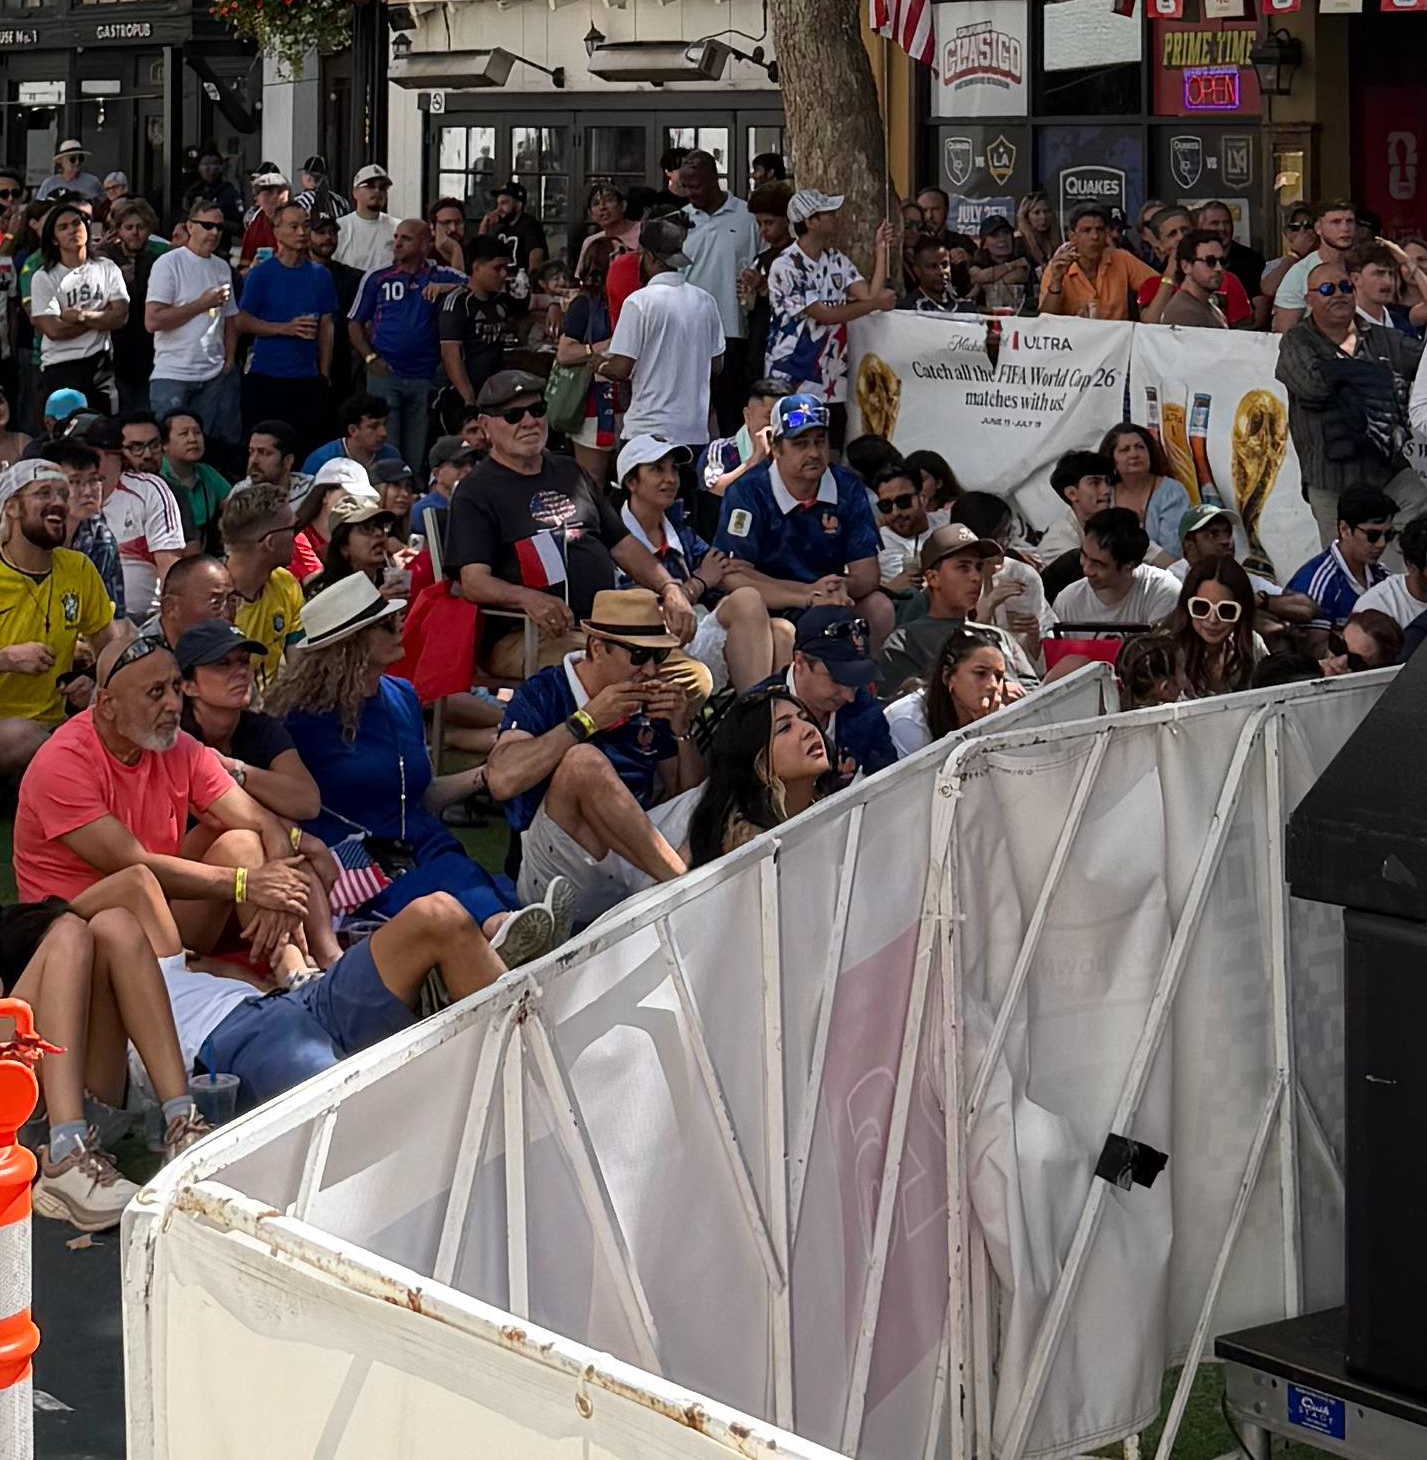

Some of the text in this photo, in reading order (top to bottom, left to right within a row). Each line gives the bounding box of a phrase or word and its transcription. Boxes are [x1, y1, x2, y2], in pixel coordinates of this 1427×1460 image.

[97, 24, 151, 39] GASTROPUB
[944, 30, 1022, 82] CLASICO
[1162, 30, 1257, 66] PRIME TIME
[1189, 75, 1236, 105] OPEN
[994, 152, 1010, 166] LA
[1066, 176, 1120, 194] QUAKES
[957, 206, 982, 223] JULY
[66, 282, 104, 307] USA
[382, 281, 404, 301] 10
[1024, 336, 1073, 351] ULTRA
[912, 361, 953, 380] Catch
[955, 364, 971, 381] all
[998, 364, 1027, 386] FIFA
[1031, 367, 1068, 388] World
[1093, 368, 1116, 387] 26
[965, 389, 1018, 410] matches
[1021, 391, 1049, 411] with
